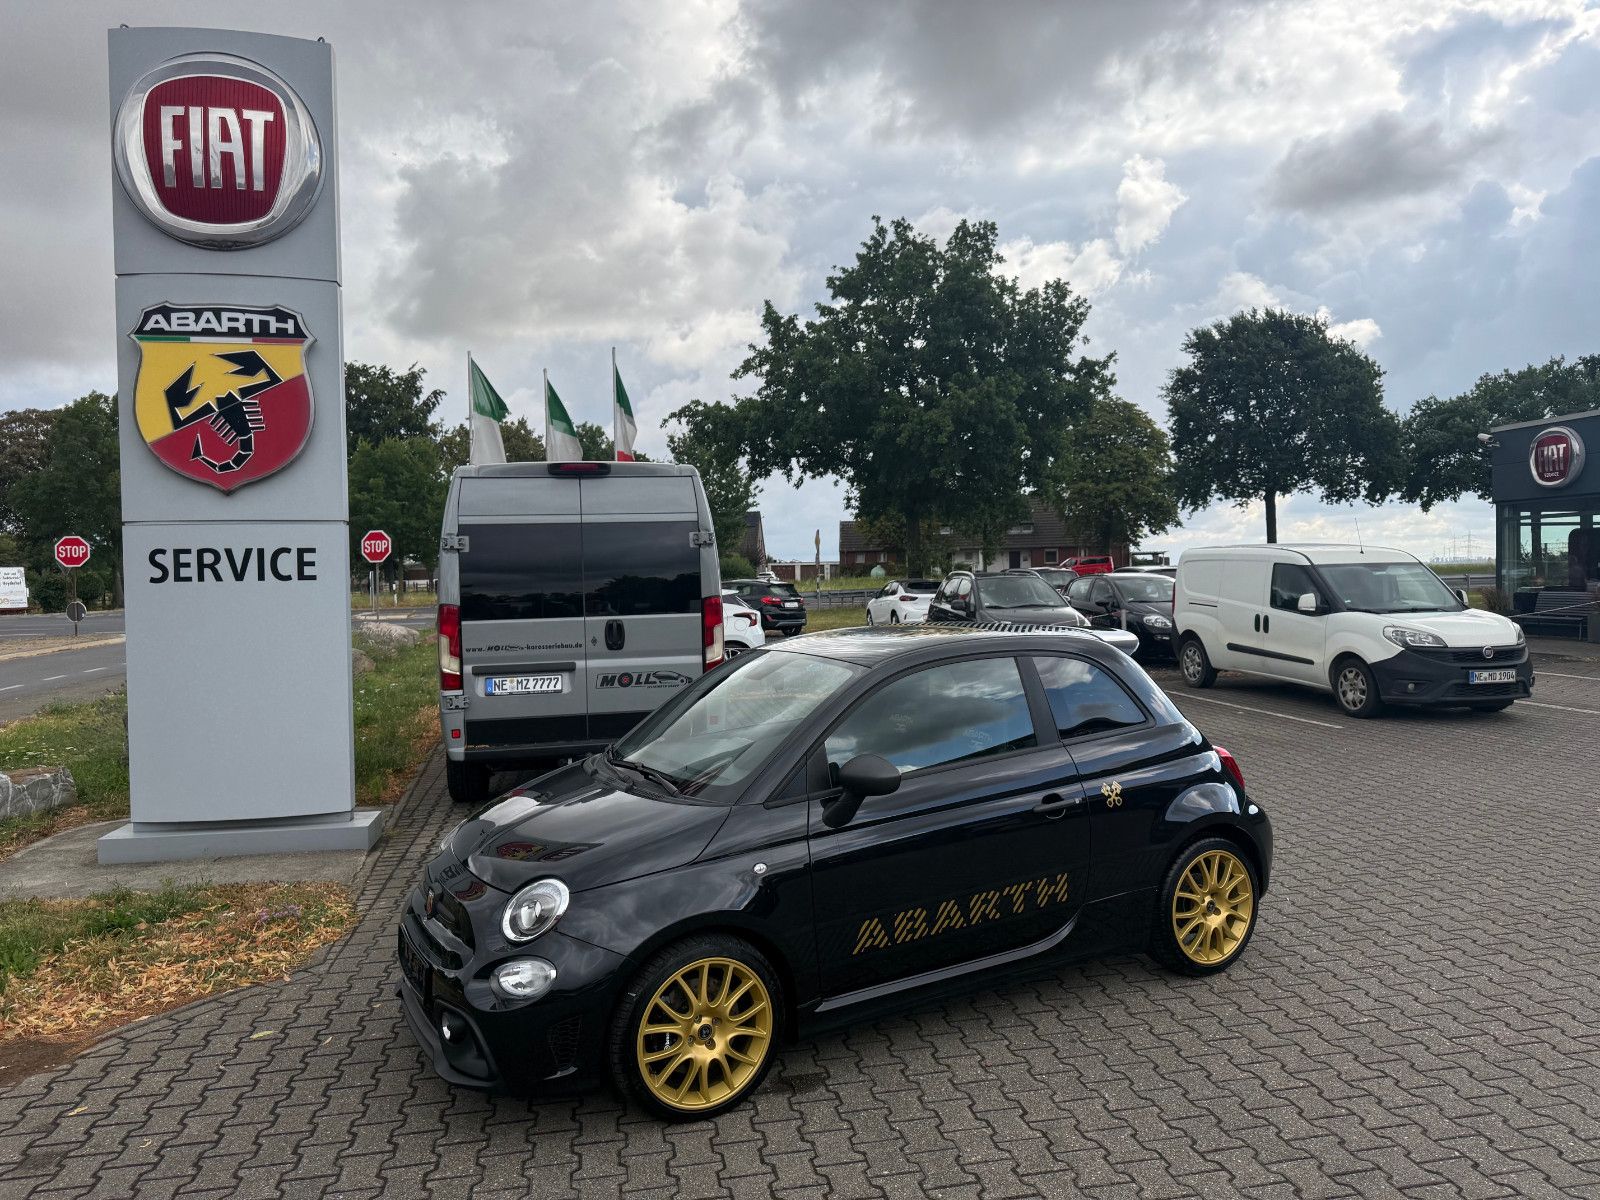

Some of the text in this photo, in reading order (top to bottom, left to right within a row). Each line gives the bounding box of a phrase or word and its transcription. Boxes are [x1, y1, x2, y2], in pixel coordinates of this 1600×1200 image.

[160, 105, 275, 191] FIAT
[142, 310, 295, 335] ABARTH
[1537, 443, 1567, 472] FIAT
[58, 545, 87, 558] STOP
[364, 540, 388, 553] STOP
[148, 547, 318, 584] SERVICE
[493, 677, 560, 692] NE MZ 7777
[600, 672, 657, 688] MOLL
[1475, 672, 1484, 682] NE
[1498, 671, 1515, 681] 1904
[852, 872, 1069, 955] ABARTH
